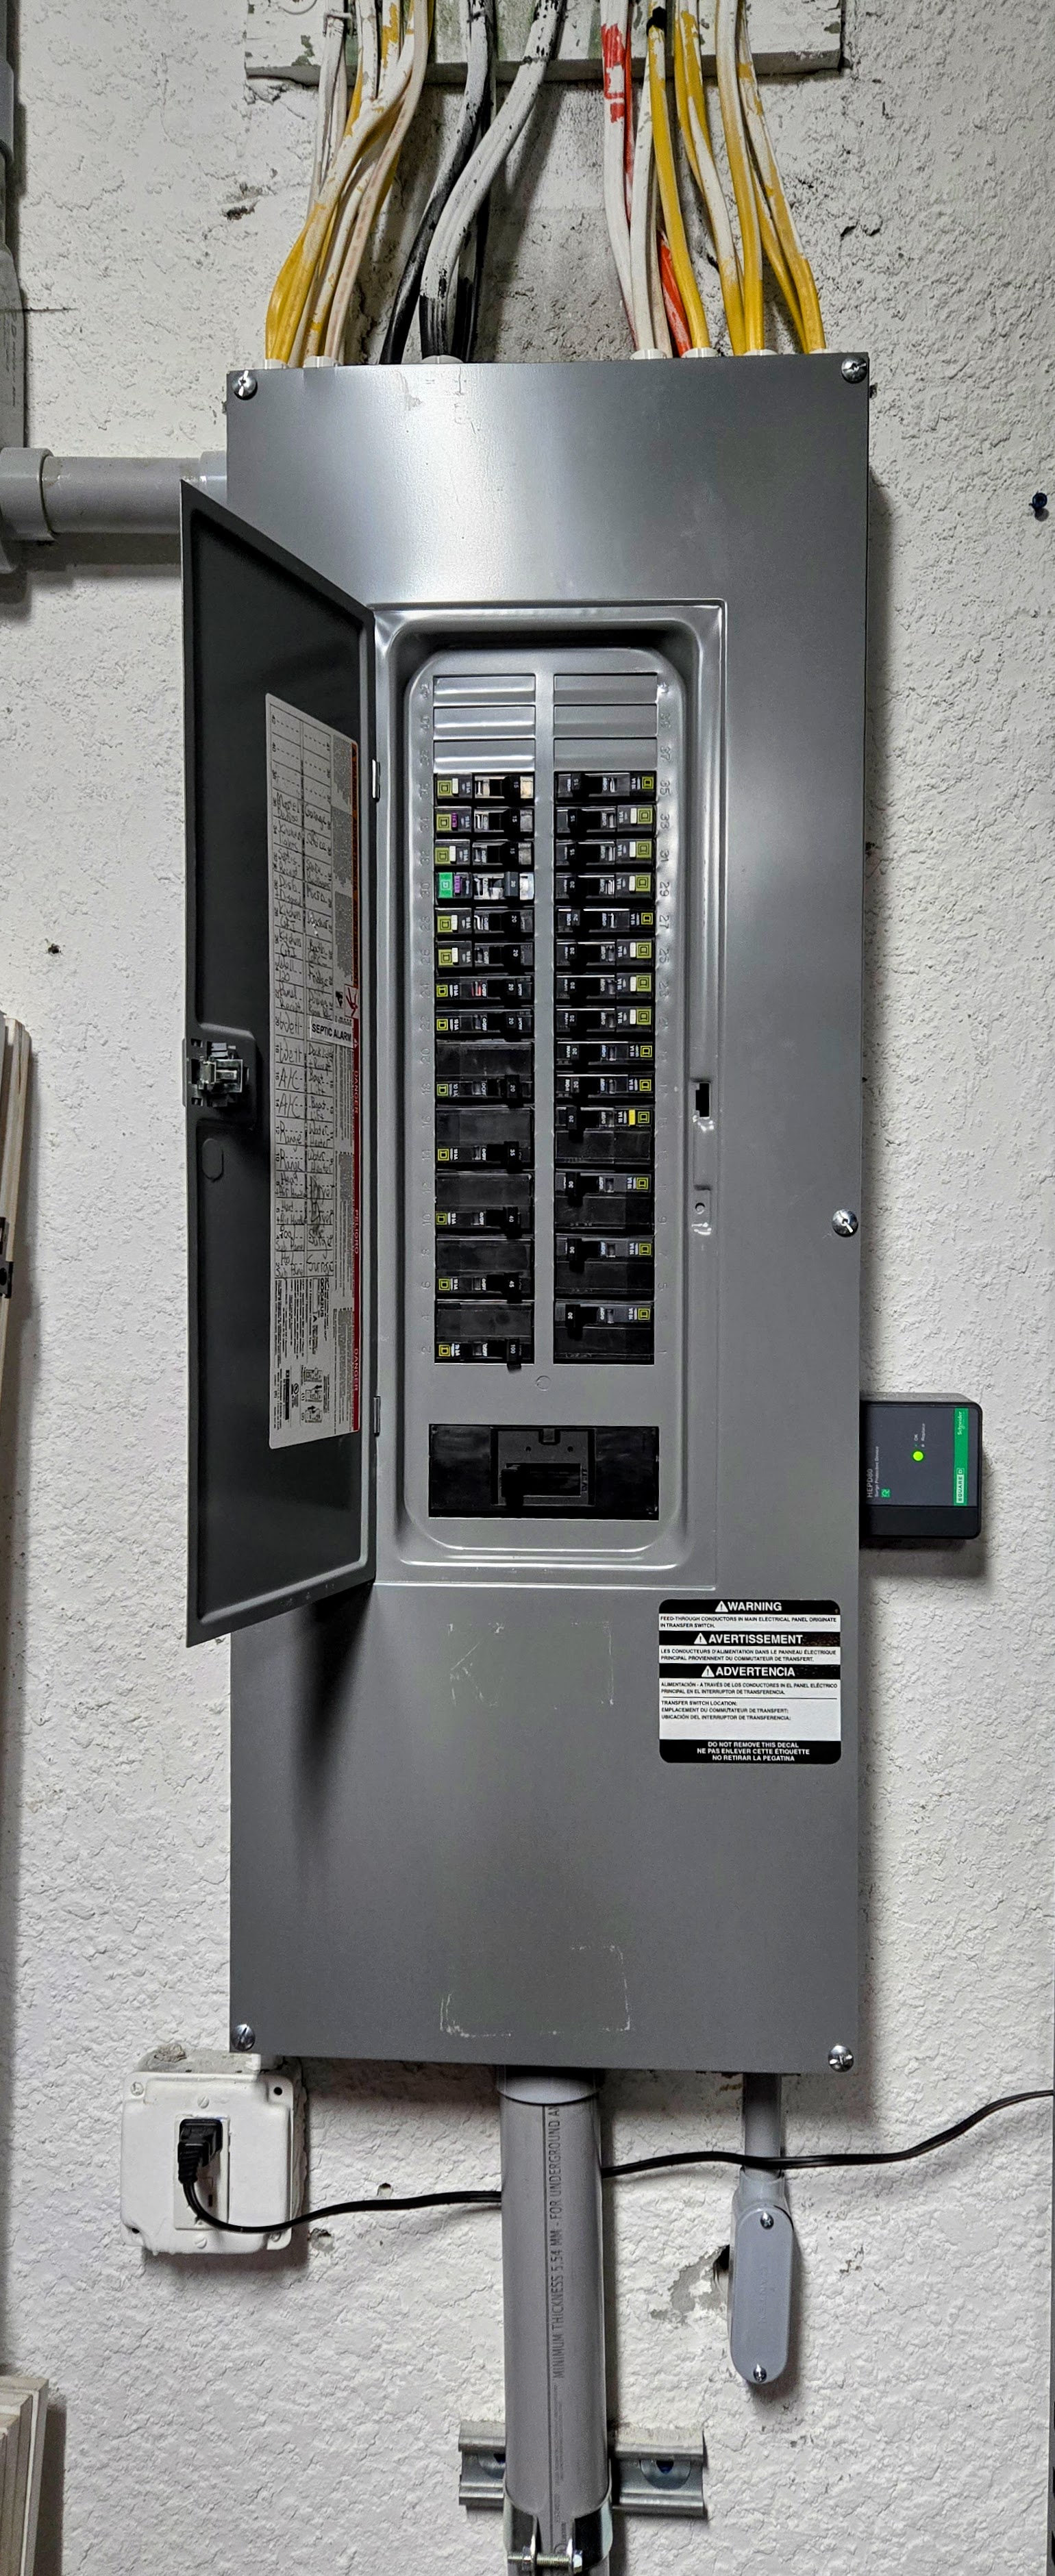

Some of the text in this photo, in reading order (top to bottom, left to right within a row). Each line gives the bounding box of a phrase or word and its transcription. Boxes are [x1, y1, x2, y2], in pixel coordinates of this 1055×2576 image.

[660, 780, 670, 796] 35
[660, 814, 670, 829] 33
[660, 850, 669, 862] 31
[659, 881, 670, 897] 29
[659, 914, 669, 929] 27
[569, 947, 575, 955] 20
[312, 1023, 351, 1041] SEPTIC ALARM
[510, 1084, 516, 1092] 20
[422, 1116, 432, 1127] 16
[569, 1246, 575, 1254] 30
[421, 1281, 431, 1290] 6
[567, 1312, 573, 1320] 30
[957, 1411, 965, 1436] Schneider
[727, 1601, 782, 1612] WARNING
[708, 1634, 803, 1644] AVERTISSEMENT
[716, 1666, 795, 1676] ADVERTENCIA
[548, 2120, 562, 2197] UNDERGROUND
[549, 2199, 562, 2220] FOR
[550, 2229, 562, 2247] MM
[551, 2275, 564, 2329] THICKNESS
[552, 2334, 564, 2379] MINIMUM
